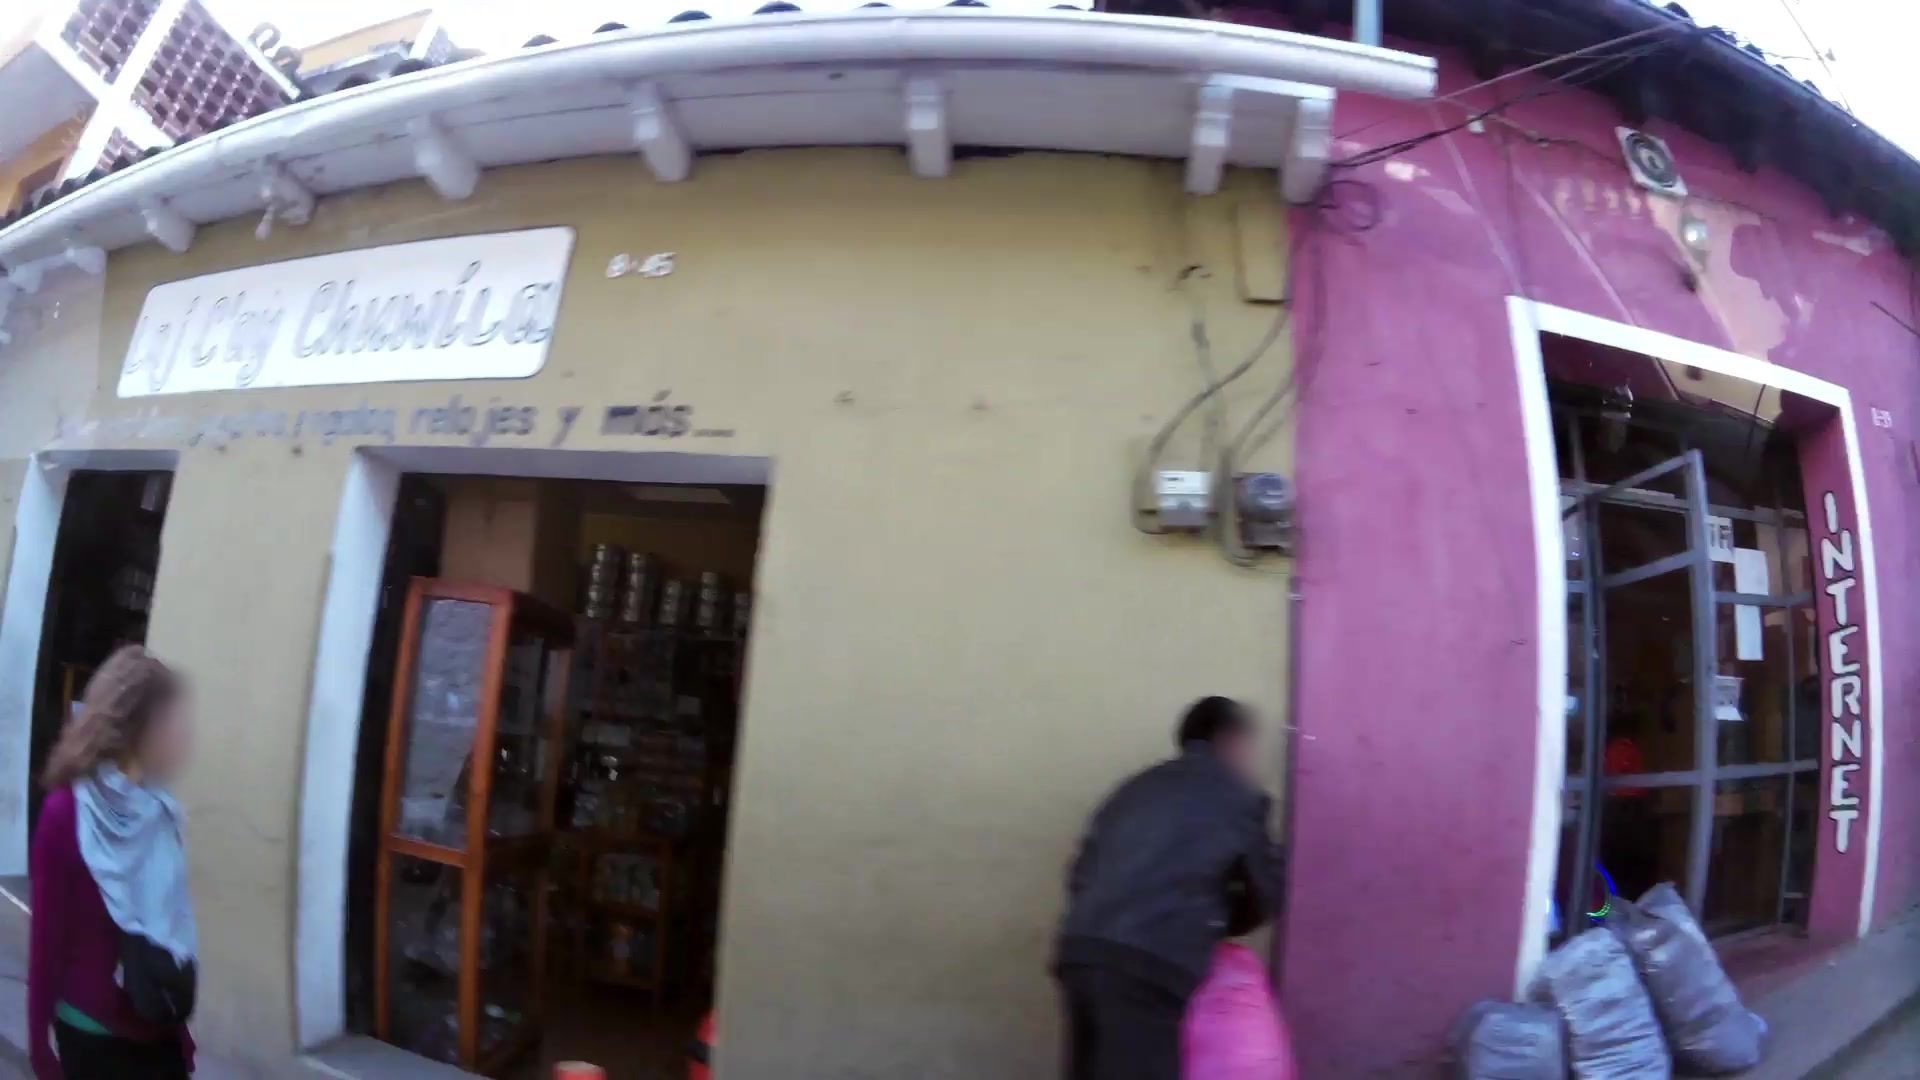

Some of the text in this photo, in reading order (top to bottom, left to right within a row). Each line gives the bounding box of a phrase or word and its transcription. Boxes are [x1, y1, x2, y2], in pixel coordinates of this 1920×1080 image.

[407, 394, 538, 447] relojes
[551, 405, 584, 448] y
[1820, 491, 1862, 854] INTERNET
